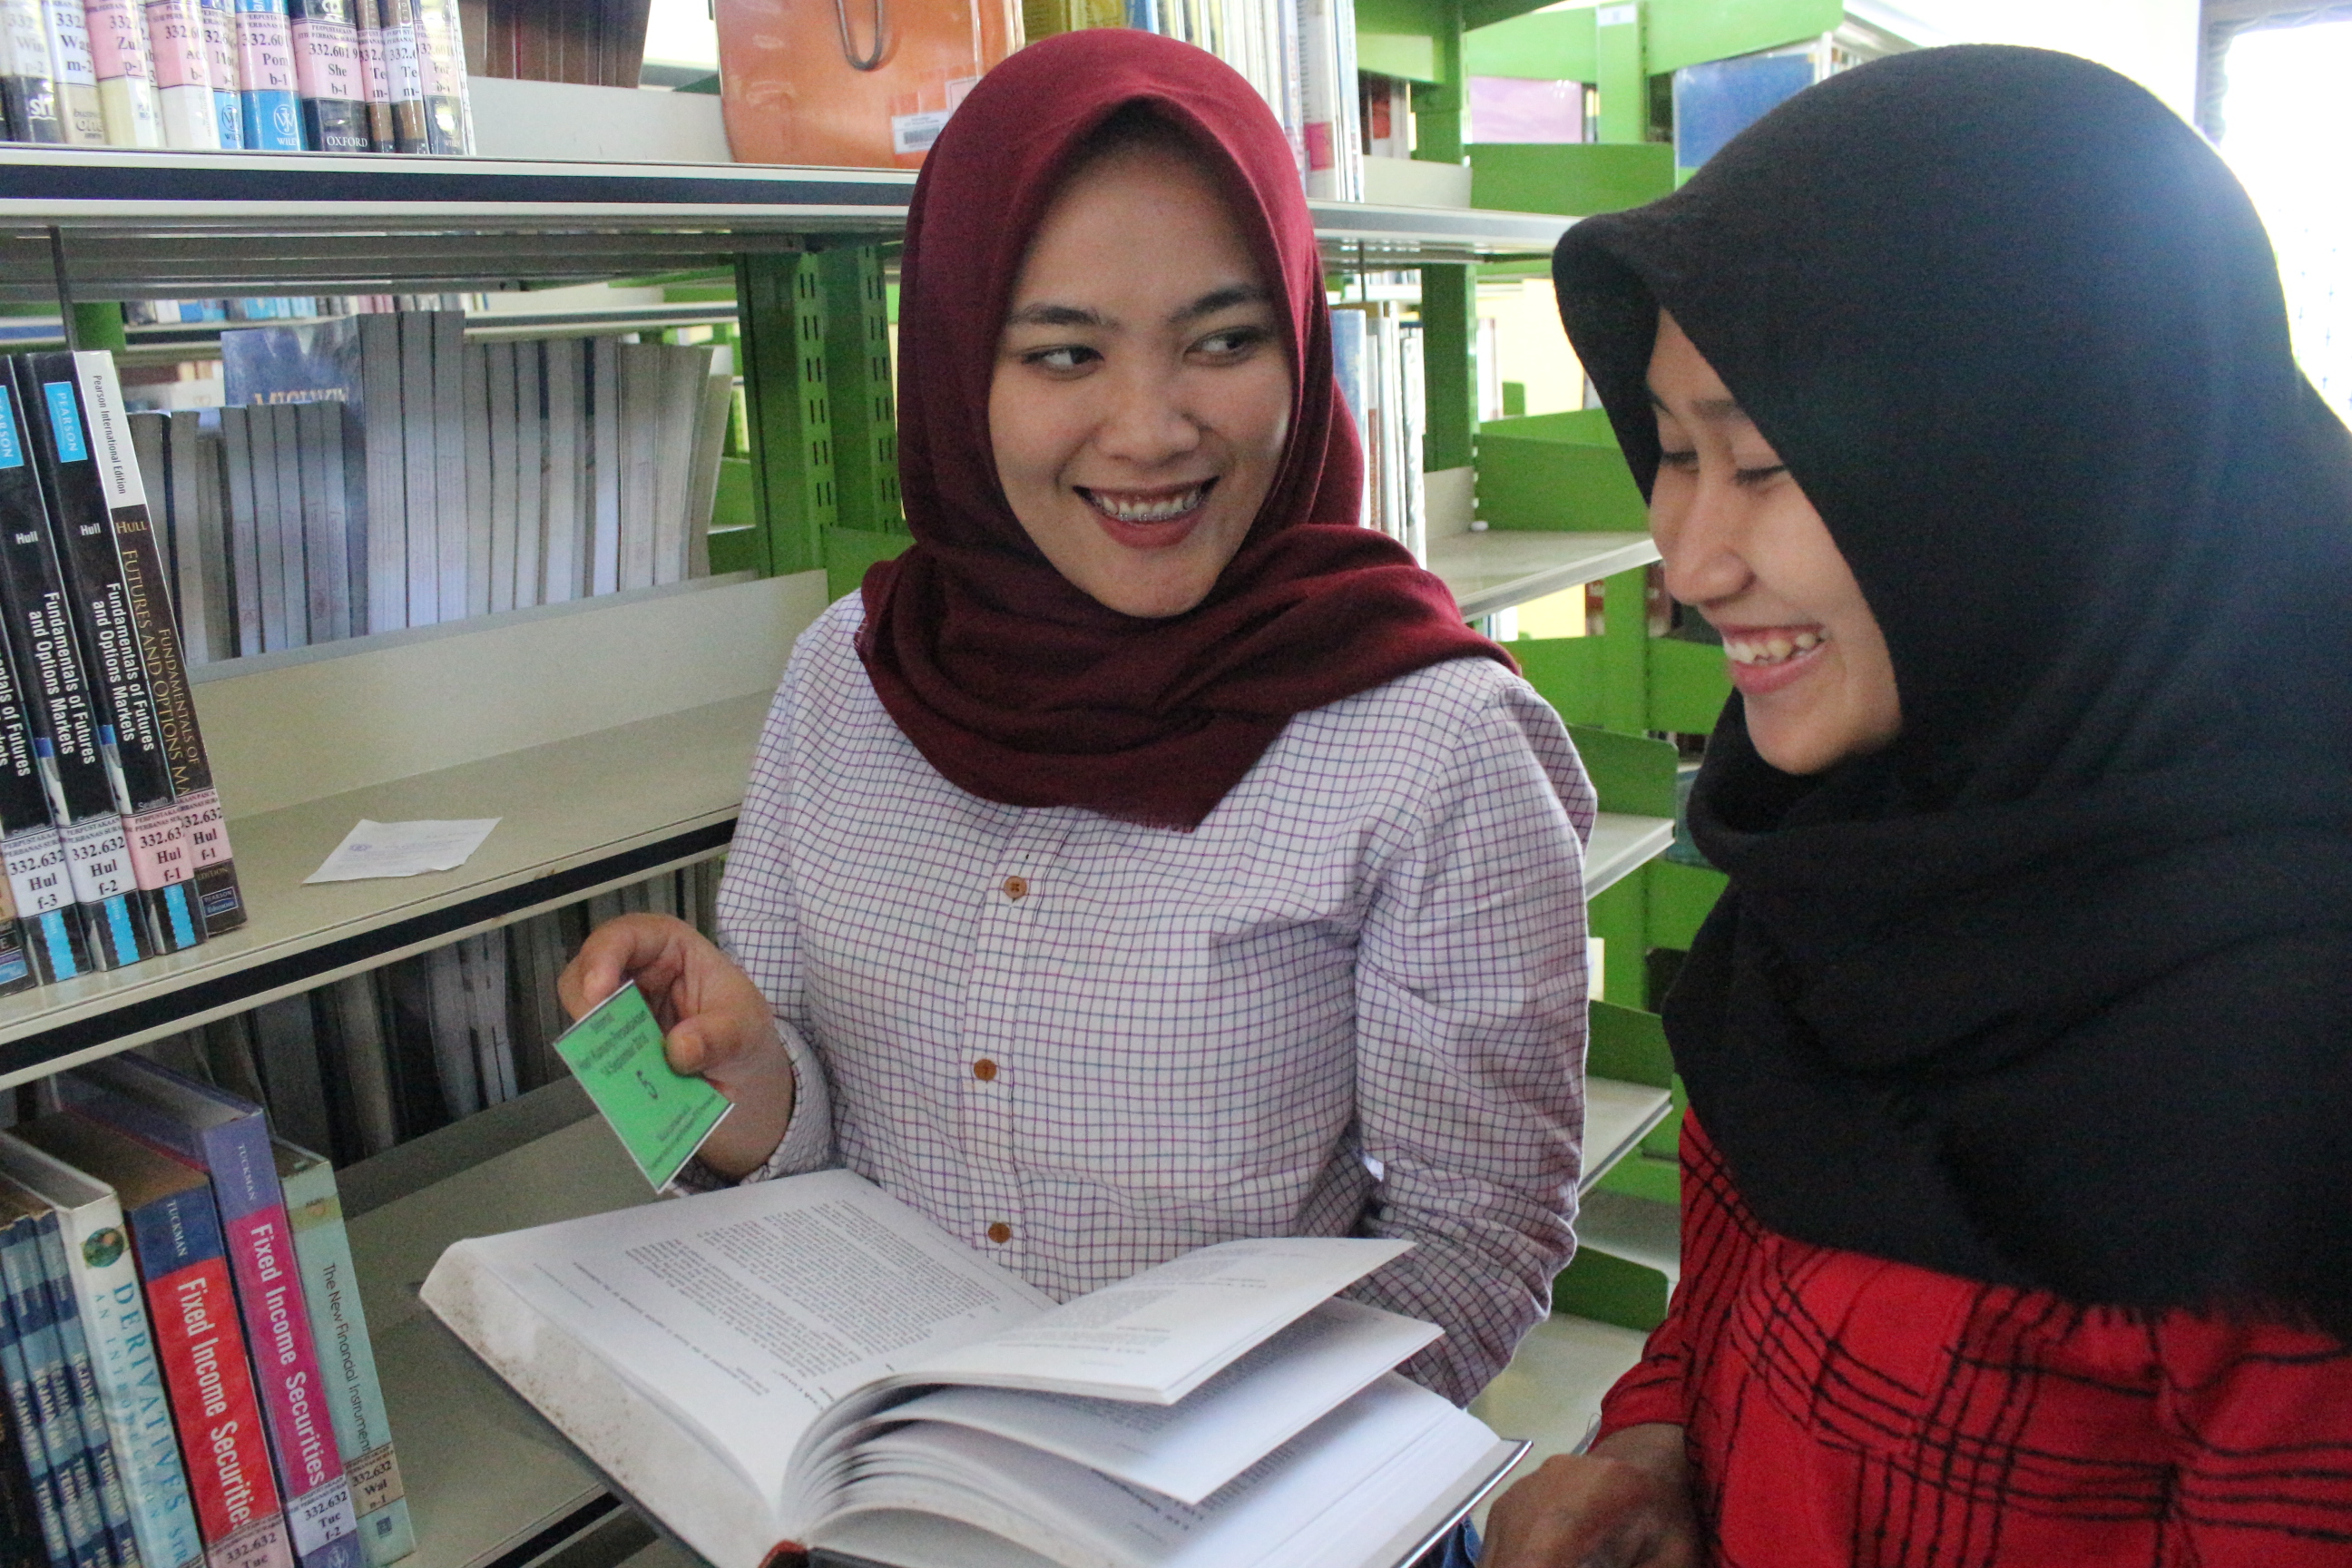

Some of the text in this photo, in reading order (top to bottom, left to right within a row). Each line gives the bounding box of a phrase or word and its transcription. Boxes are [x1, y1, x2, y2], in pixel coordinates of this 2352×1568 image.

[262, 53, 289, 66] Pom
[328, 64, 348, 76] She
[269, 73, 288, 86] b-1
[330, 83, 348, 96] b-1
[276, 137, 299, 146] WILEY
[326, 136, 368, 148] OXFORD
[56, 391, 79, 452] PEARSON
[93, 375, 126, 495] Pearson International Edition
[15, 530, 39, 545] Hull
[80, 523, 102, 536] Hull
[115, 521, 148, 534] HULL
[106, 582, 155, 751] Fundamentals of Futures
[122, 549, 153, 630] FUTURES
[143, 633, 163, 676] AND
[153, 680, 183, 761] OPTIONS
[29, 611, 74, 755] and Options Markets
[44, 592, 96, 765] Fundamentals of Futures
[93, 600, 135, 742] and Options Markets
[159, 628, 200, 766] FUNDAMENTALS OF
[6, 722, 32, 777] Futures
[181, 807, 223, 829] 32.632
[72, 836, 125, 861] 332.632
[140, 826, 186, 849] 332.63
[192, 828, 218, 845] Hul
[9, 849, 65, 876] 332.632
[90, 858, 118, 877] Hul
[156, 847, 181, 865] Hul
[201, 848, 217, 861] f-1
[28, 873, 58, 891] Hul
[98, 879, 118, 896] f-2
[163, 867, 181, 883] f-1
[37, 893, 58, 910] f-3
[238, 1143, 258, 1202] TUCKMAN
[167, 1199, 189, 1258] TUCKMAN
[250, 1222, 281, 1283] Fixed
[323, 1262, 337, 1290] The
[177, 1277, 215, 1338] Fixed
[328, 1290, 344, 1323] New
[265, 1285, 298, 1366] Income
[336, 1321, 358, 1384] Financial
[191, 1336, 228, 1417] Income
[113, 1281, 186, 1514] DERIVATIVES
[286, 1371, 327, 1487] Securities
[352, 1459, 392, 1488] 332.632
[364, 1479, 388, 1496] Wal
[304, 1491, 348, 1521] 332.632
[318, 1512, 342, 1528] Tuc
[227, 1532, 277, 1564] 332.632
